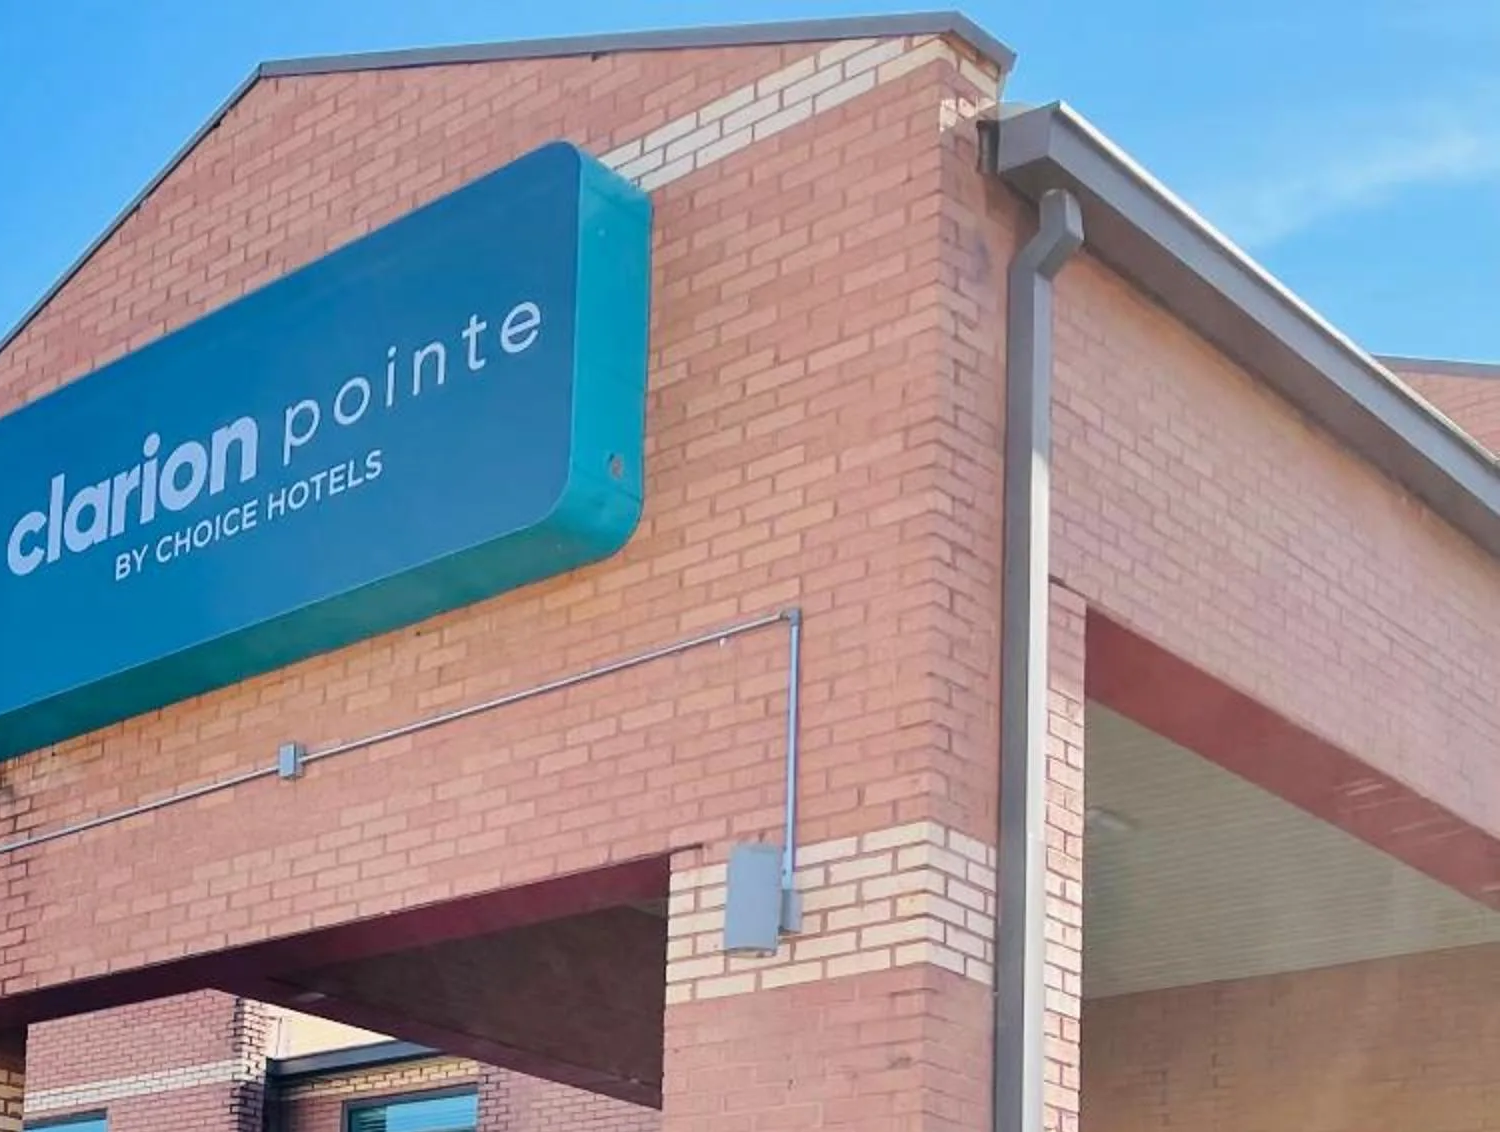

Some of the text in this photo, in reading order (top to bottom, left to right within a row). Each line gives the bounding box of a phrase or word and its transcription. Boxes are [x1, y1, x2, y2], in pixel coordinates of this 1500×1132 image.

[6, 299, 542, 577] clarion pointe
[113, 450, 384, 582] BY CHOICE HOTELS
